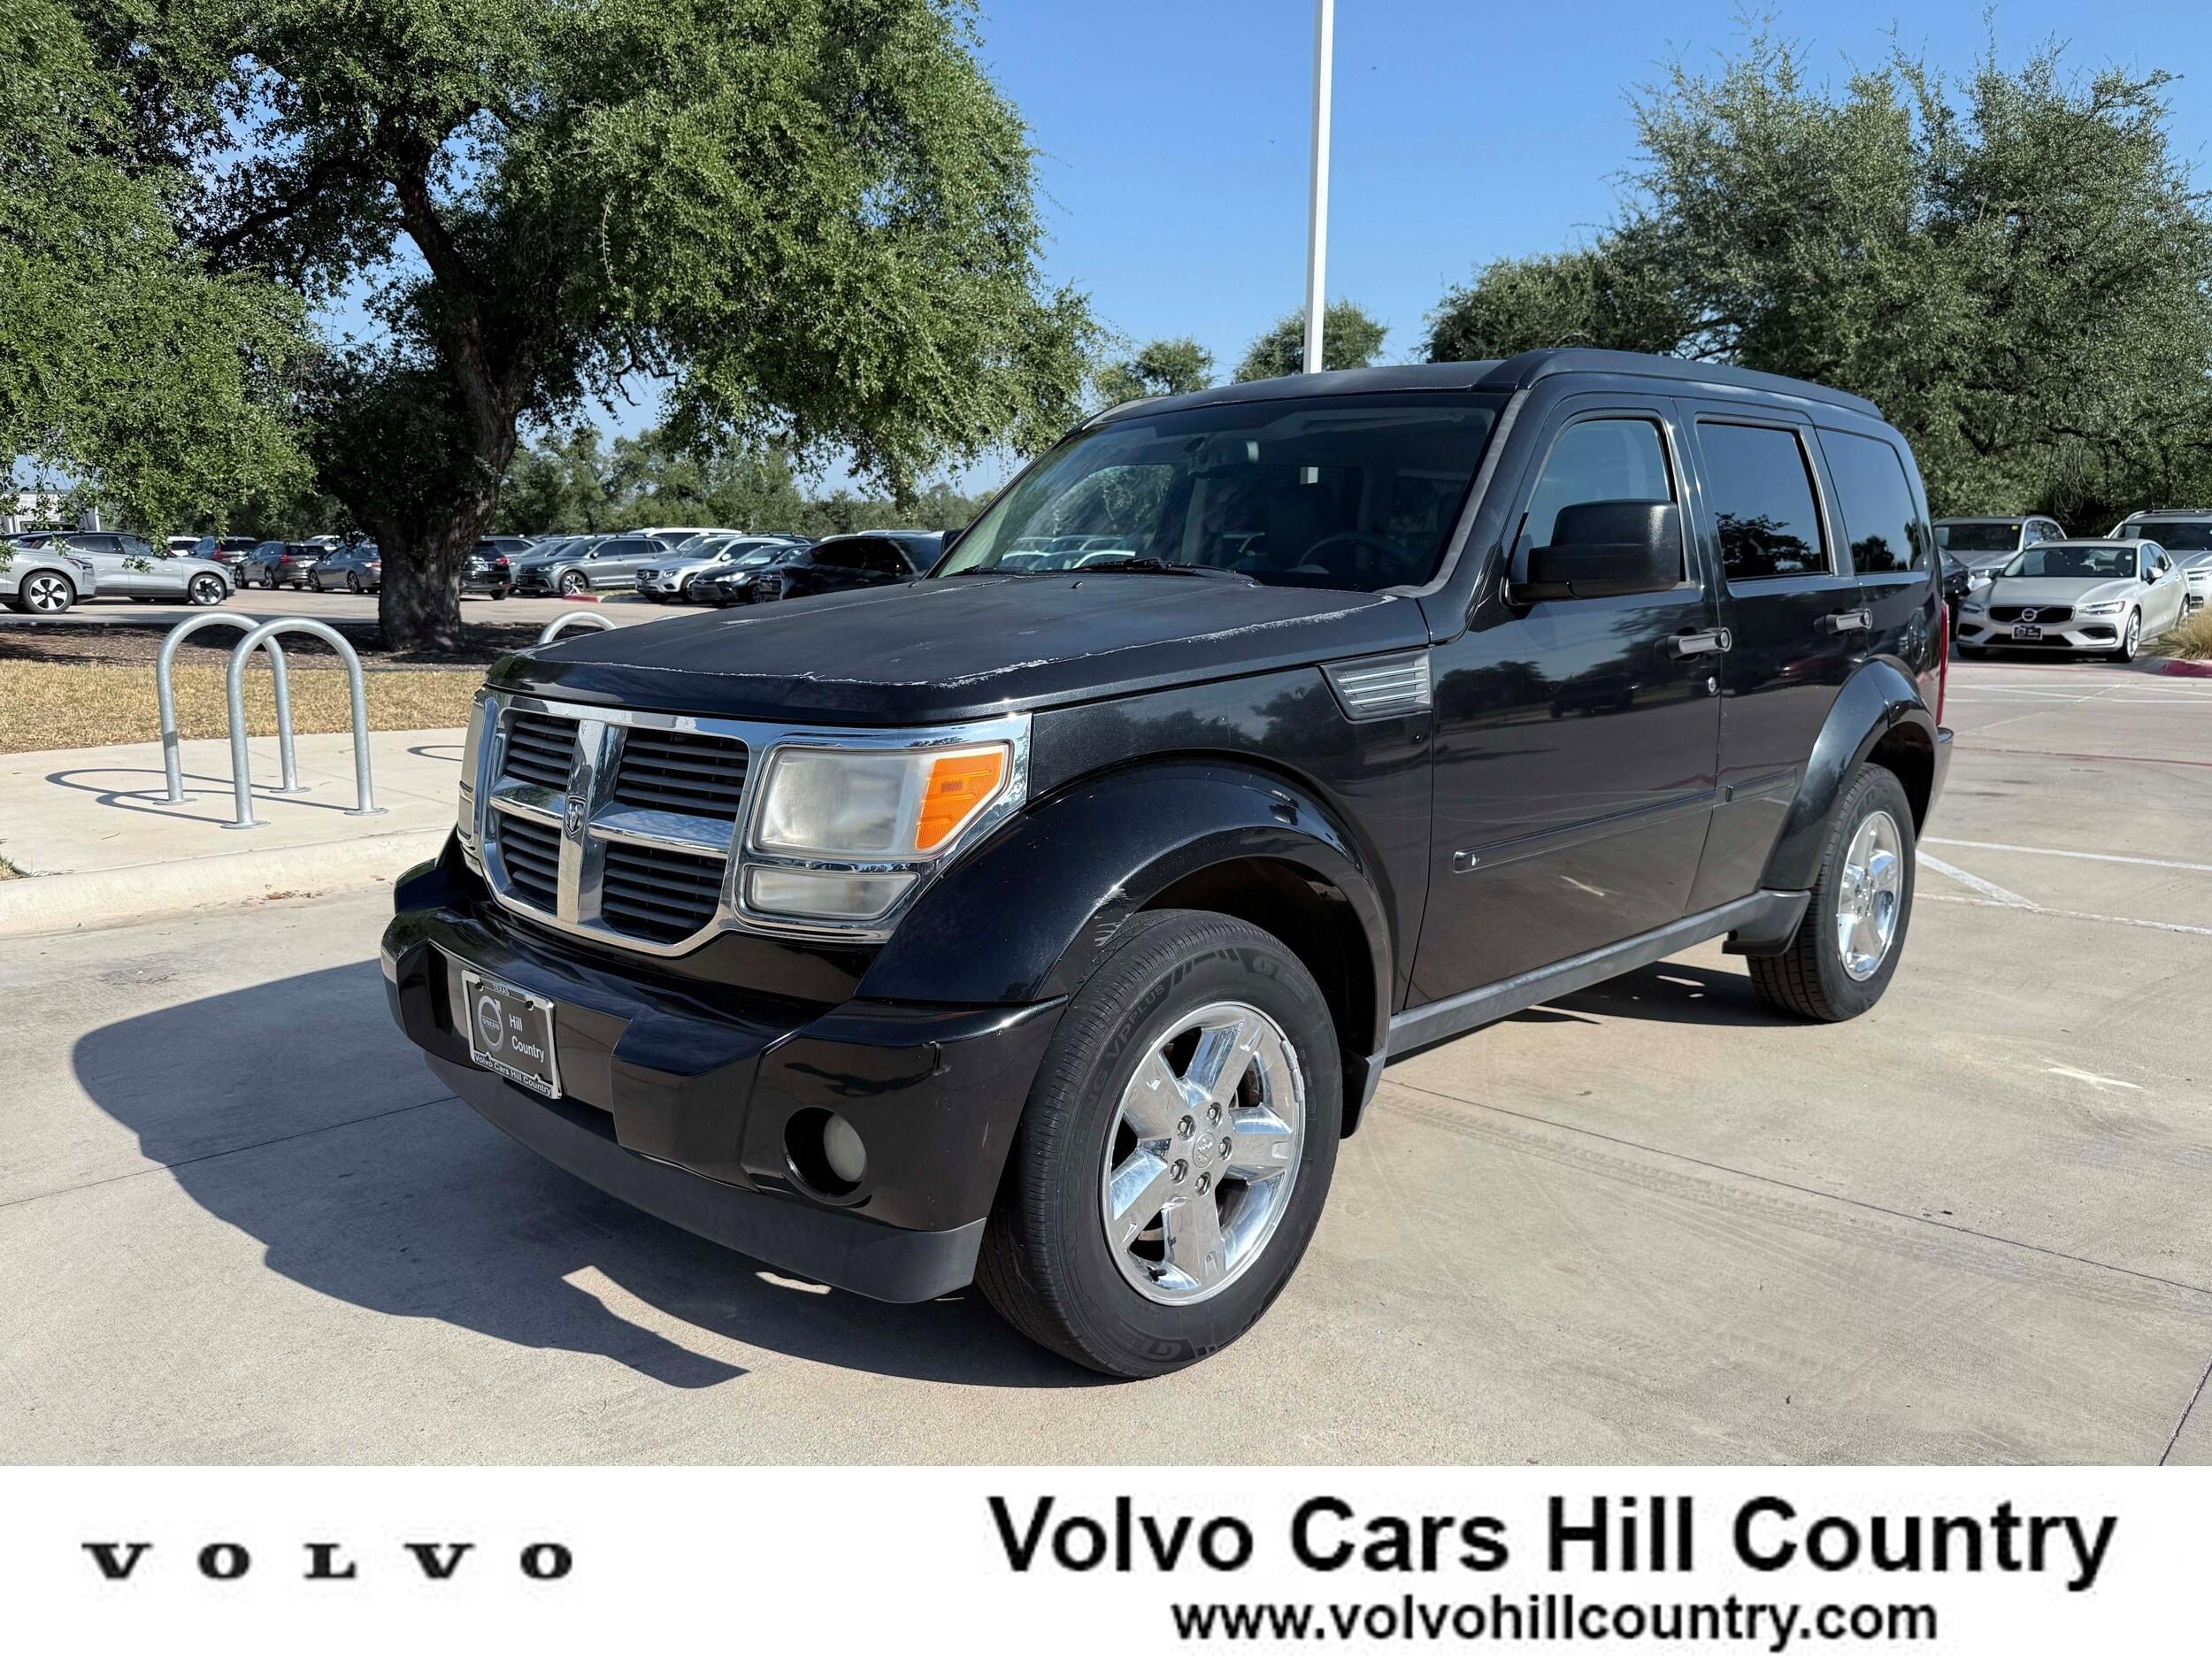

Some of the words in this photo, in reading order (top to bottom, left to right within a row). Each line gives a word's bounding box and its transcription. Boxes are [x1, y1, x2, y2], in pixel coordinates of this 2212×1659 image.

[493, 983, 511, 996] TEXAS
[482, 1018, 501, 1031] VOLVO
[509, 1013, 523, 1032] Hill
[511, 1035, 545, 1063] Country
[474, 1053, 494, 1067] Volvo
[494, 1063, 510, 1076] Cars
[511, 1069, 522, 1081] Hill
[523, 1076, 552, 1096] Country
